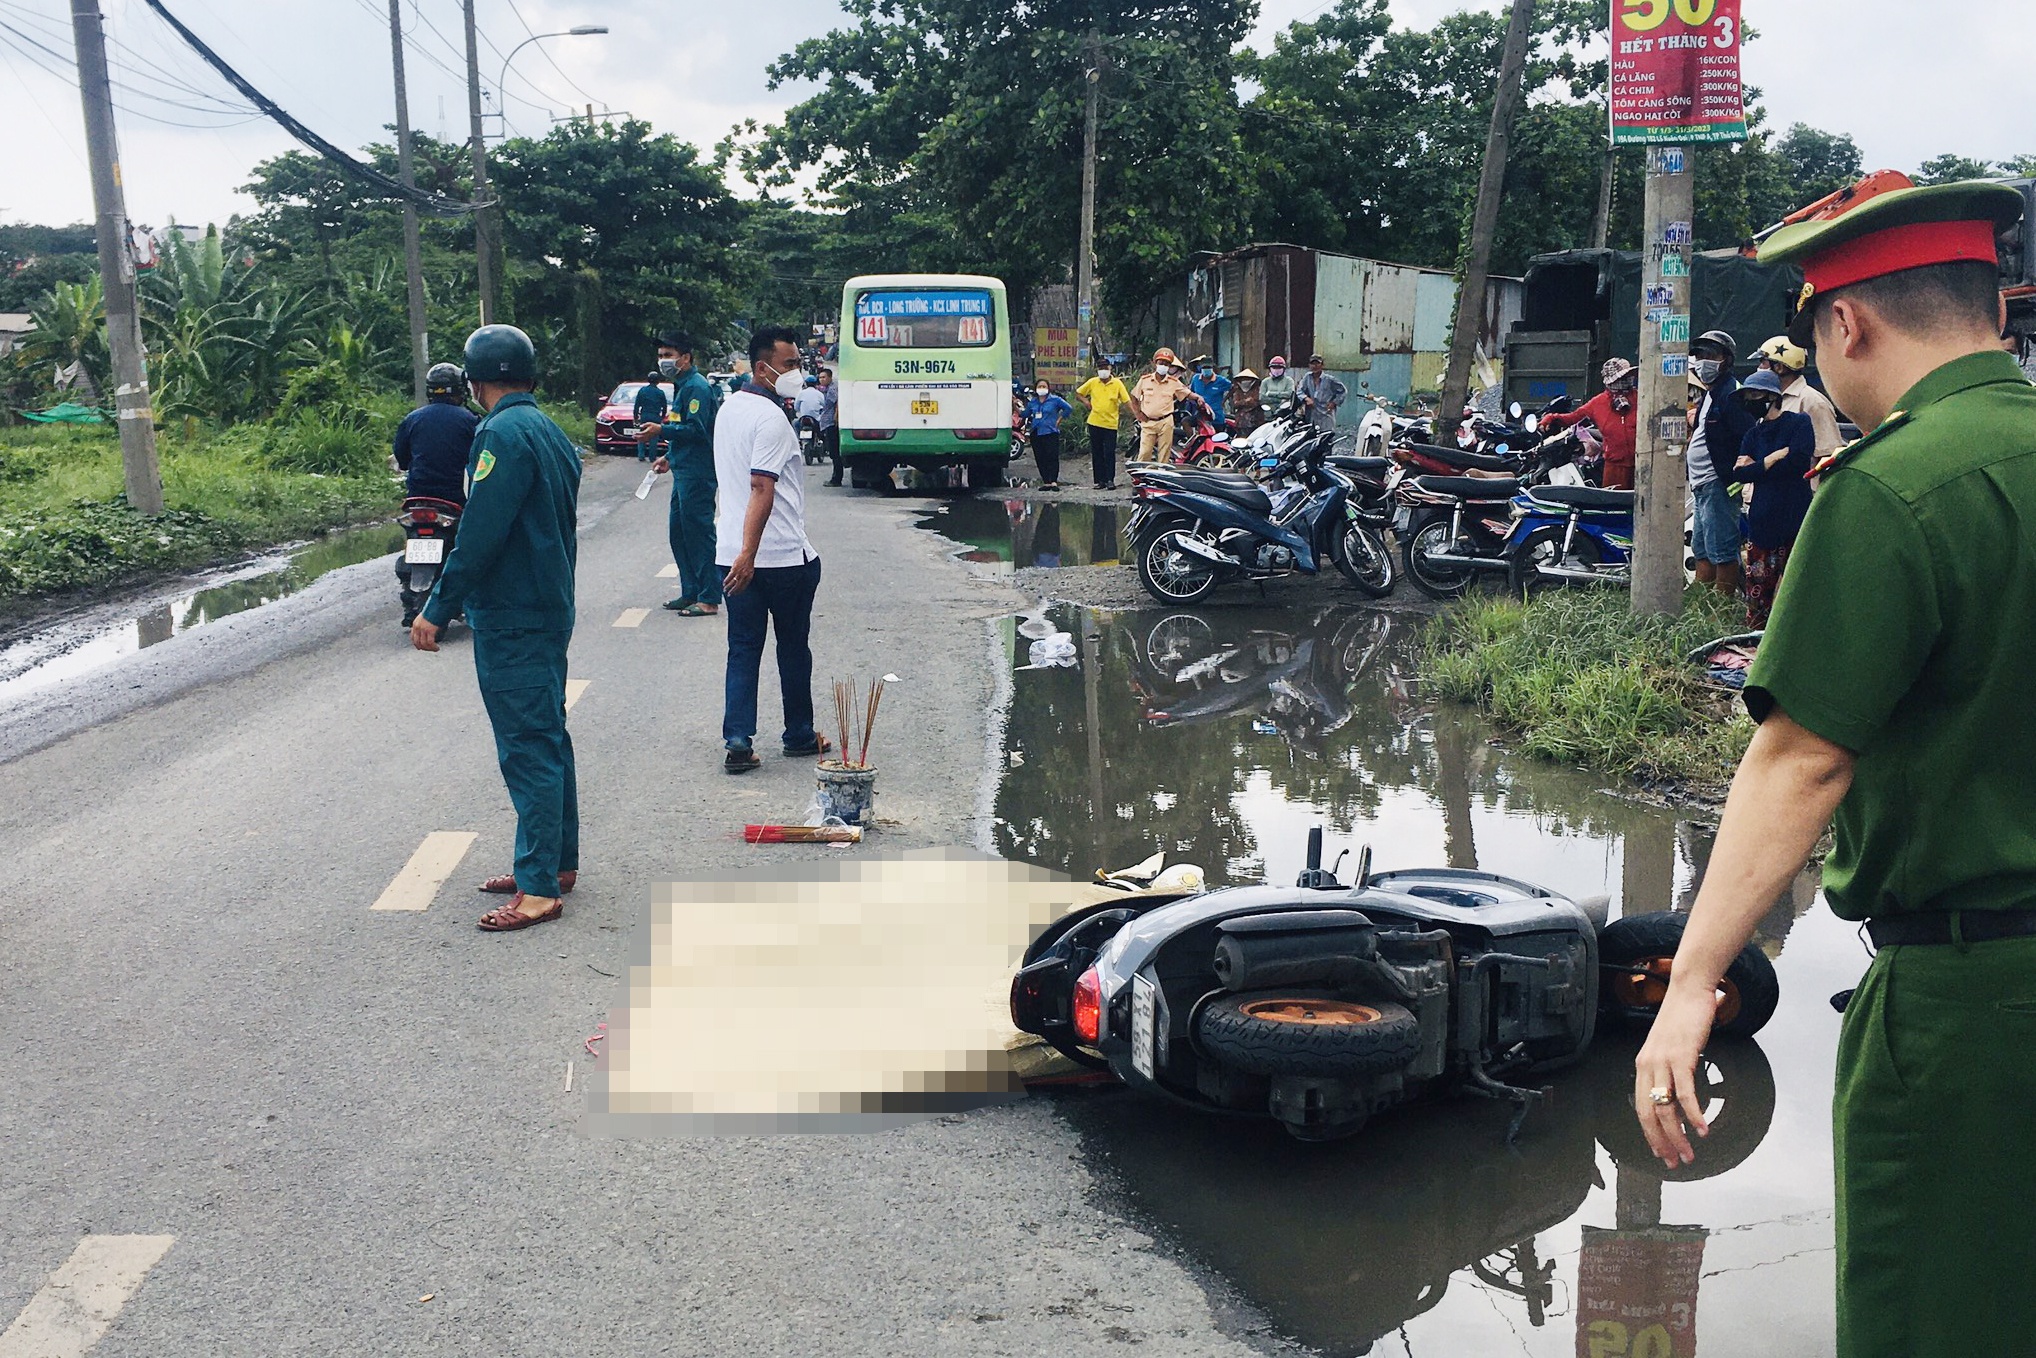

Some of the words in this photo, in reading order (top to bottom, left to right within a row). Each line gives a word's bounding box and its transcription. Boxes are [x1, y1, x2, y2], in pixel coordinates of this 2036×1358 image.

[1620, 36, 1653, 53] HẾT
[1658, 32, 1708, 50] THÁNG
[1713, 16, 1733, 48] 3
[1614, 59, 1635, 69] HÀU
[1614, 72, 1627, 82] CÁ
[1614, 86, 1627, 95] CÁ
[1629, 86, 1654, 95] CHIM
[1614, 98, 1636, 108] TÔM
[1638, 97, 1664, 107] CÀNG
[1666, 95, 1692, 106] SÔNG
[1615, 112, 1642, 120] NGAO
[1644, 112, 1661, 120] HAI
[861, 318, 883, 338] 141
[962, 318, 984, 340] 141
[895, 360, 956, 373] 53N-9674
